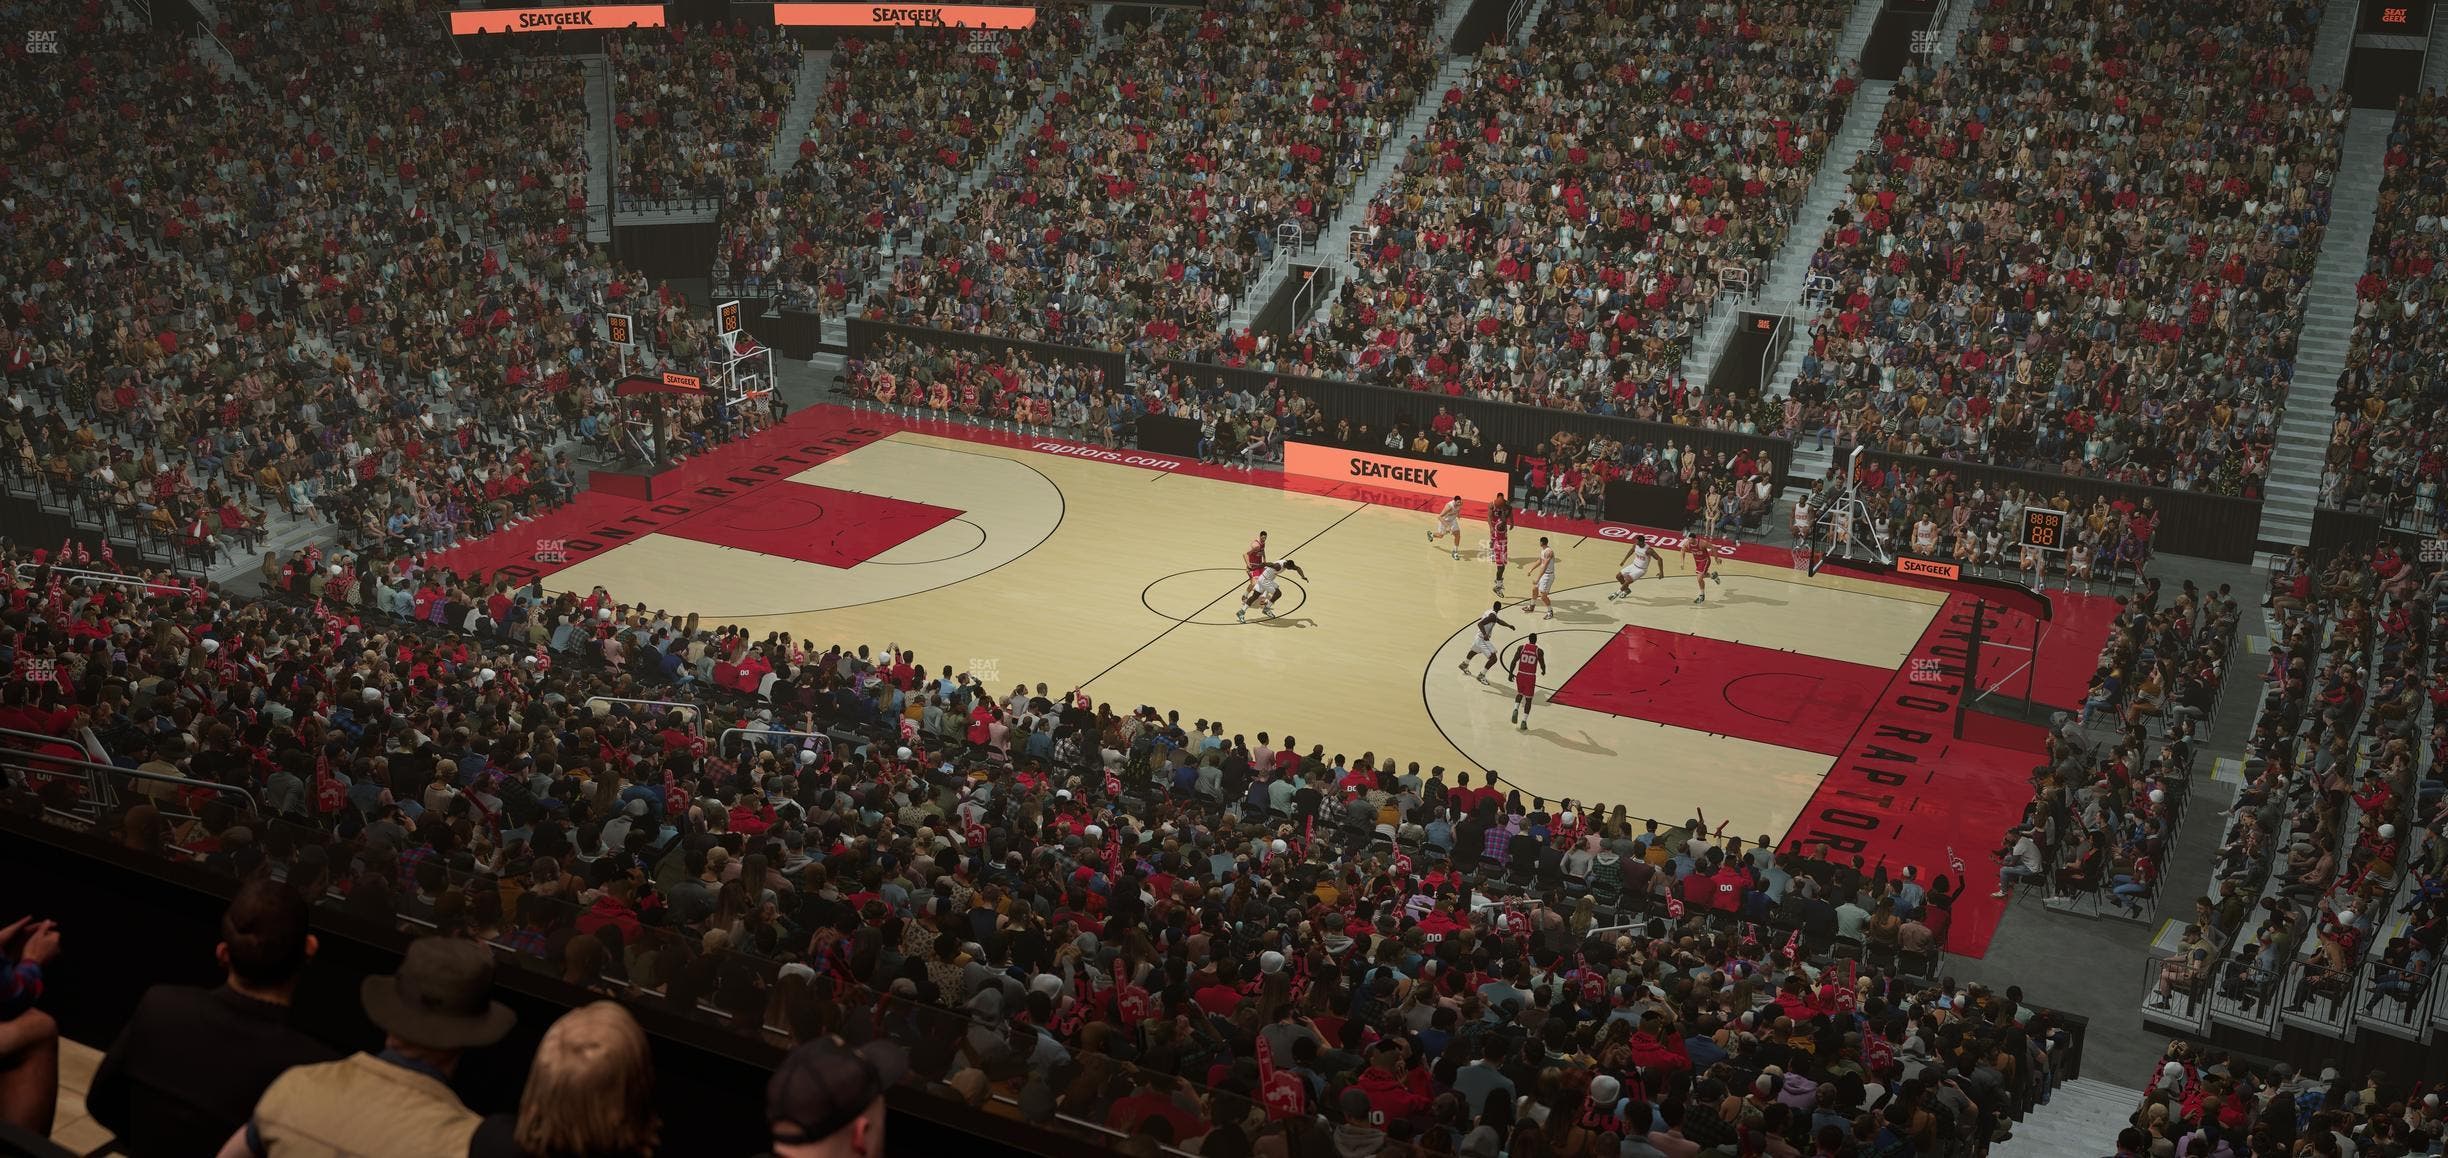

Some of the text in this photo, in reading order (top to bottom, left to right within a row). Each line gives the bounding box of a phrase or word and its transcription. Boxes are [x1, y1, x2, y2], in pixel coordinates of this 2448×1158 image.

[519, 10, 593, 28] SEATGEEK
[872, 8, 942, 22] SEATGEEK
[2382, 15, 2406, 23] GEEK
[2384, 8, 2407, 16] SEAT
[666, 375, 697, 387] SEATGEEK
[695, 427, 881, 498] RAPTORS
[1033, 441, 1181, 470] raptors.com
[1350, 458, 1438, 488] SEATGEEK
[2030, 513, 2059, 527] 88 88
[1598, 526, 1737, 556] @rapts
[2032, 526, 2054, 545] 88
[1903, 561, 1952, 577] SEATGEEK
[1520, 653, 1537, 665] 00
[1803, 725, 1933, 854] RAPTOR
[1720, 884, 1733, 892] 00
[1427, 933, 1442, 943] 00
